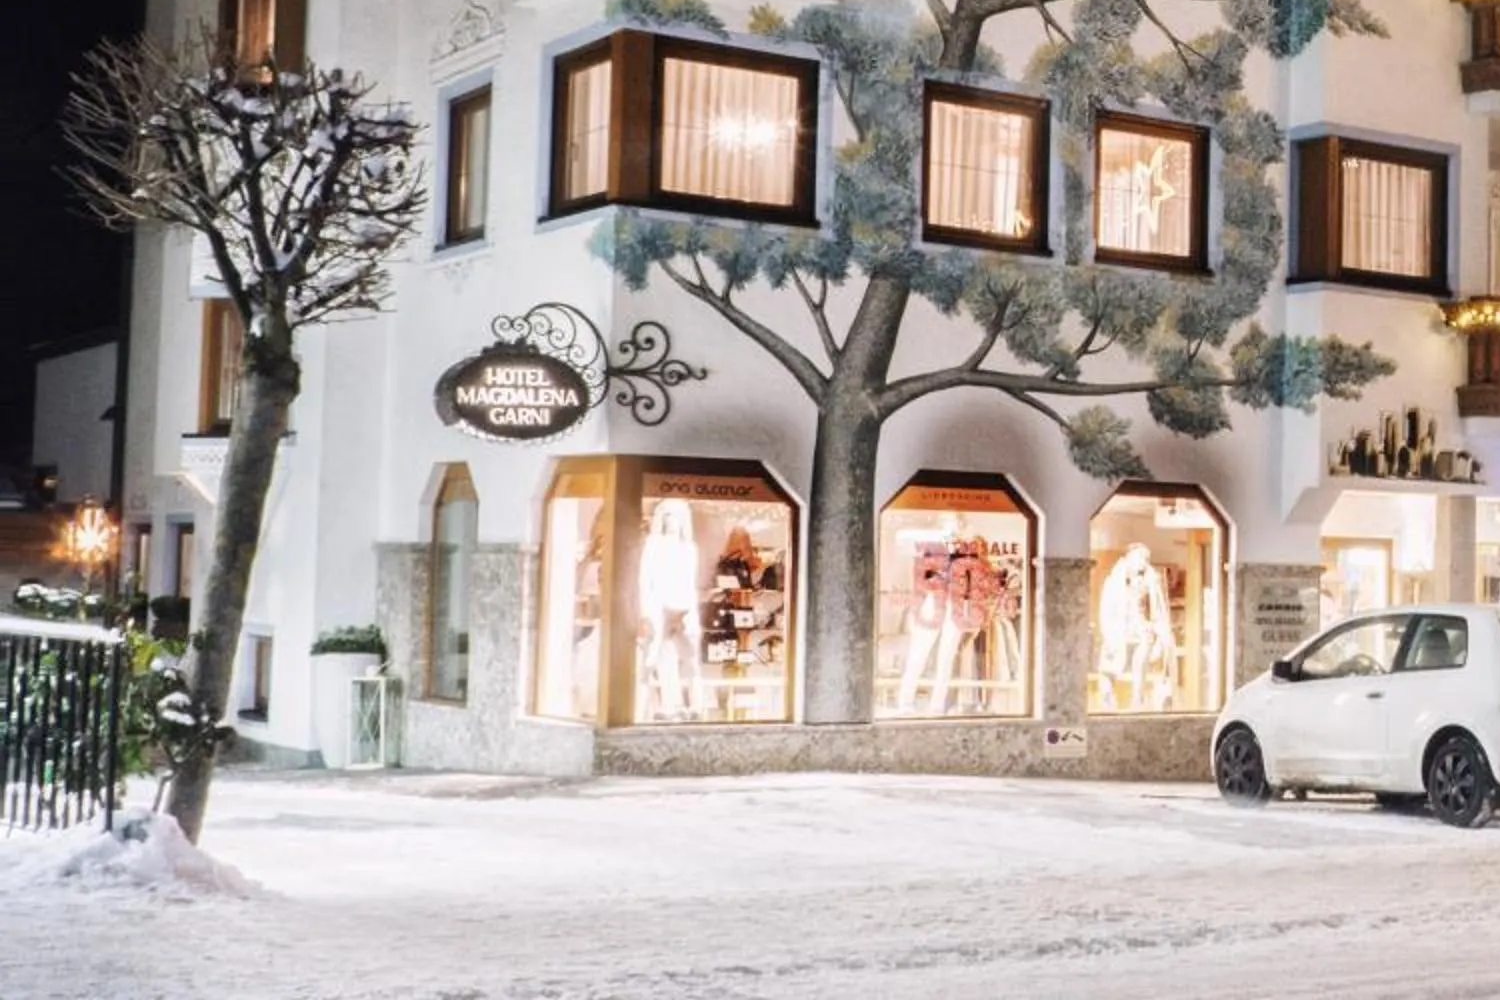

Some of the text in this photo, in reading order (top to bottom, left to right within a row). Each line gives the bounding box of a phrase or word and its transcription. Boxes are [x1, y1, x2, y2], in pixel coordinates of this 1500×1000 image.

[486, 367, 550, 385] HOTEL
[456, 386, 579, 407] MAGDALENA
[488, 407, 551, 426] GARNI
